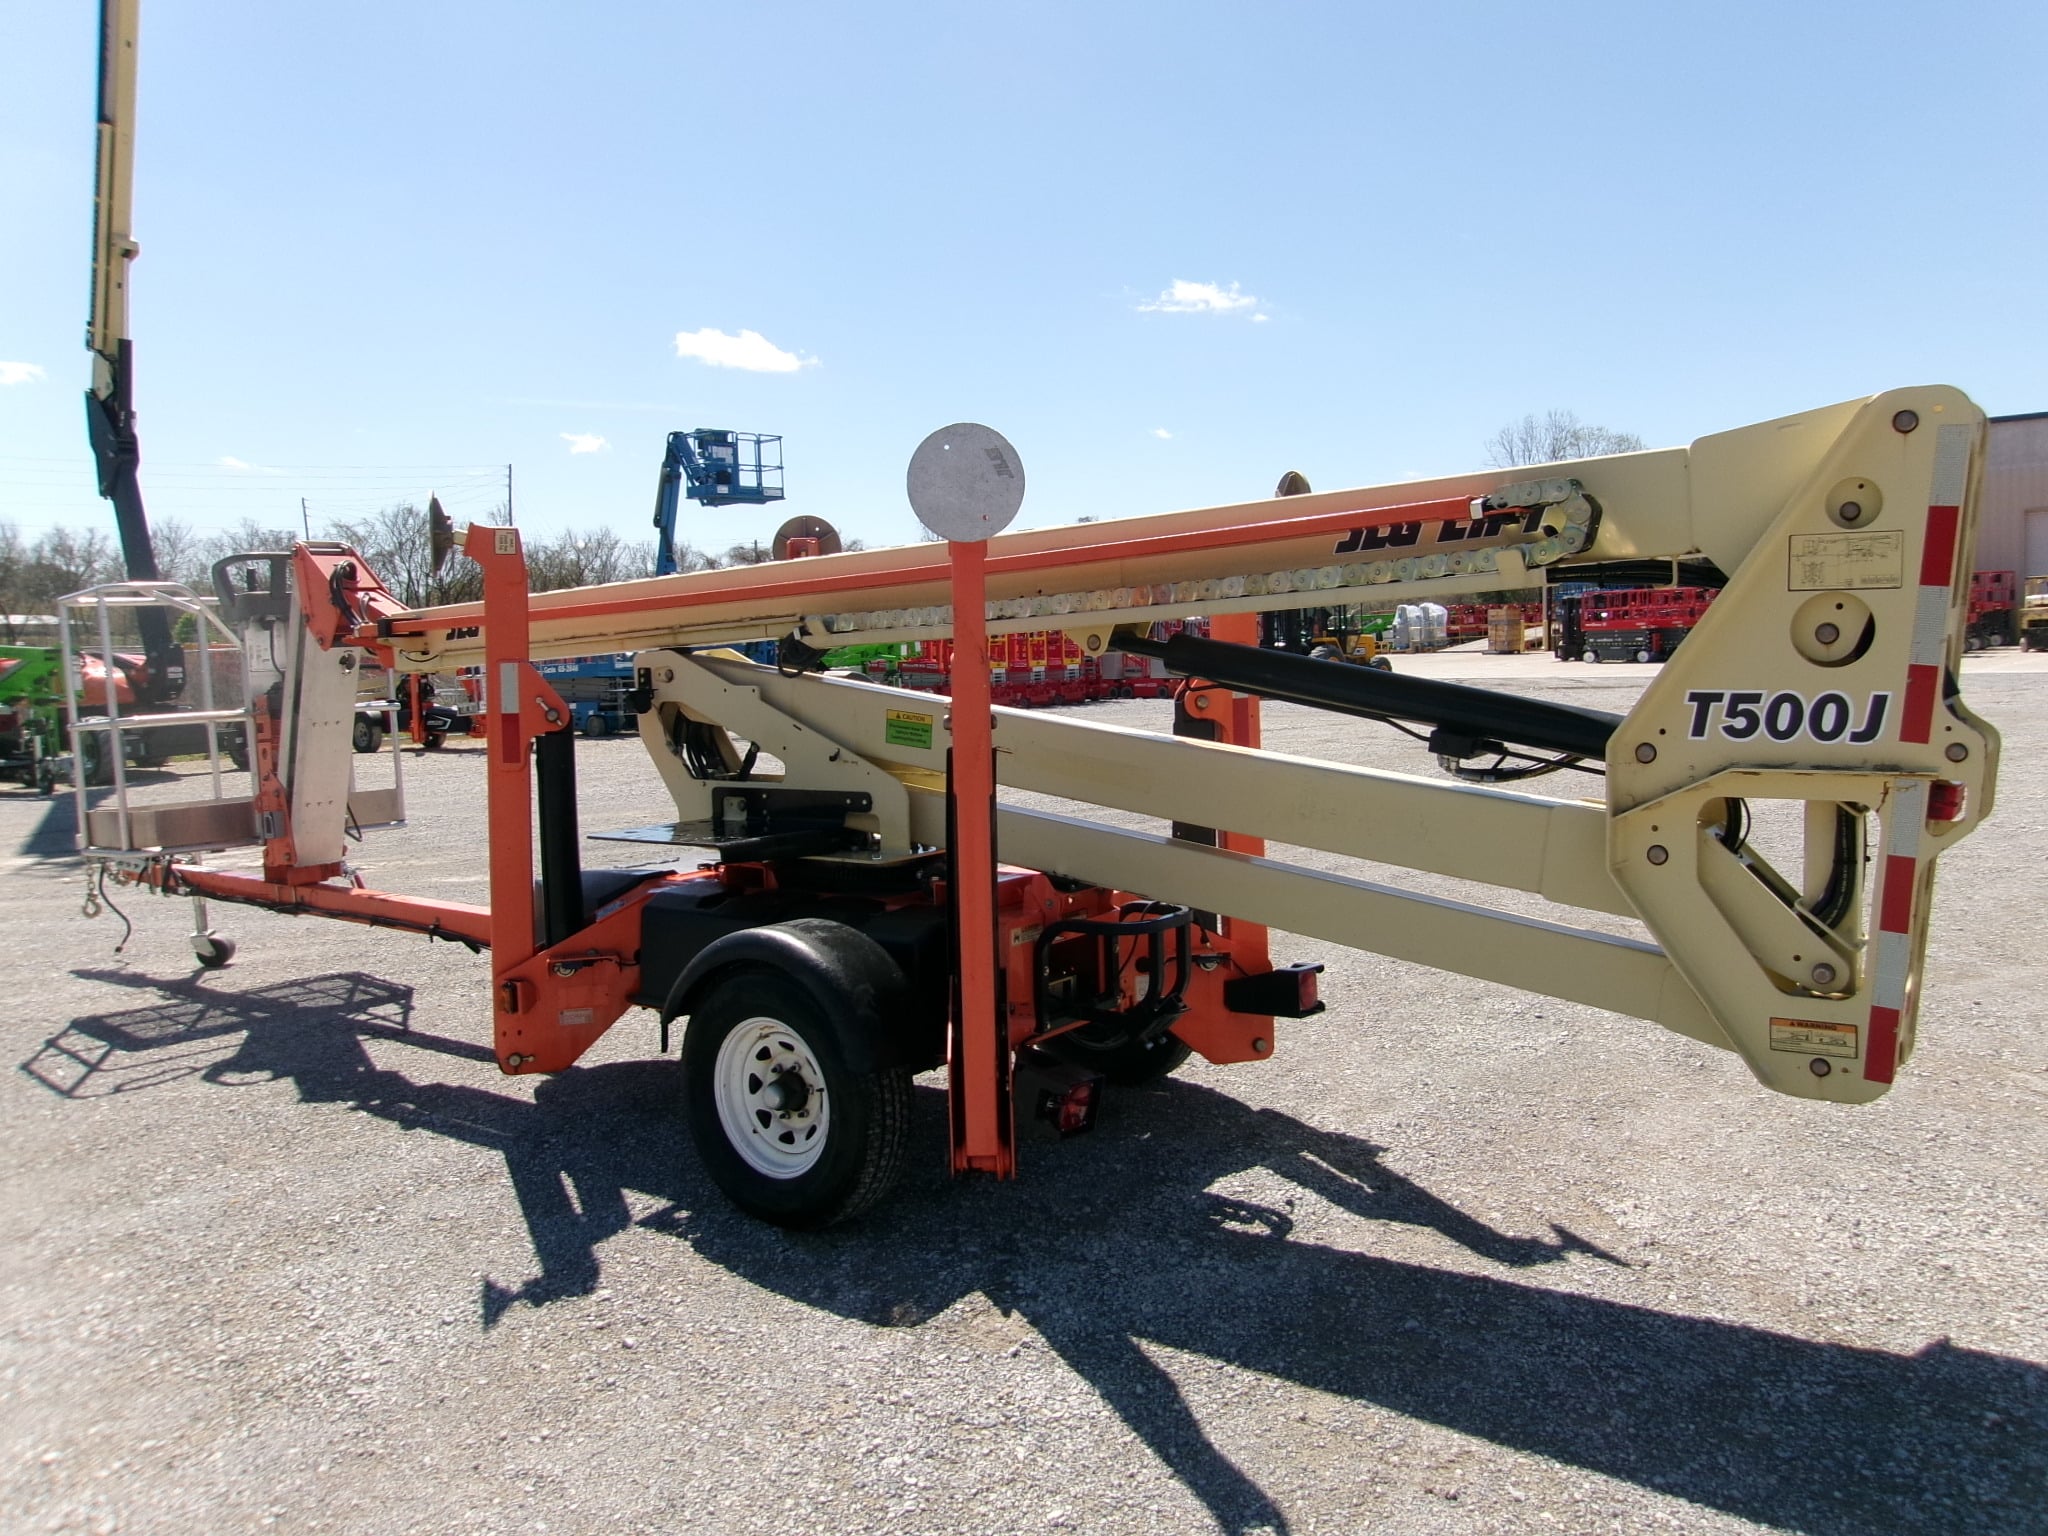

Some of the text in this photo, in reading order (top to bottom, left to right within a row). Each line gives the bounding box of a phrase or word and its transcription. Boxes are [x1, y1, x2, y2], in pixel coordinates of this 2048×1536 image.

[903, 713, 926, 723] CAUTION
[1686, 690, 1891, 744] T500J
[1796, 1021, 1837, 1031] WARNING
